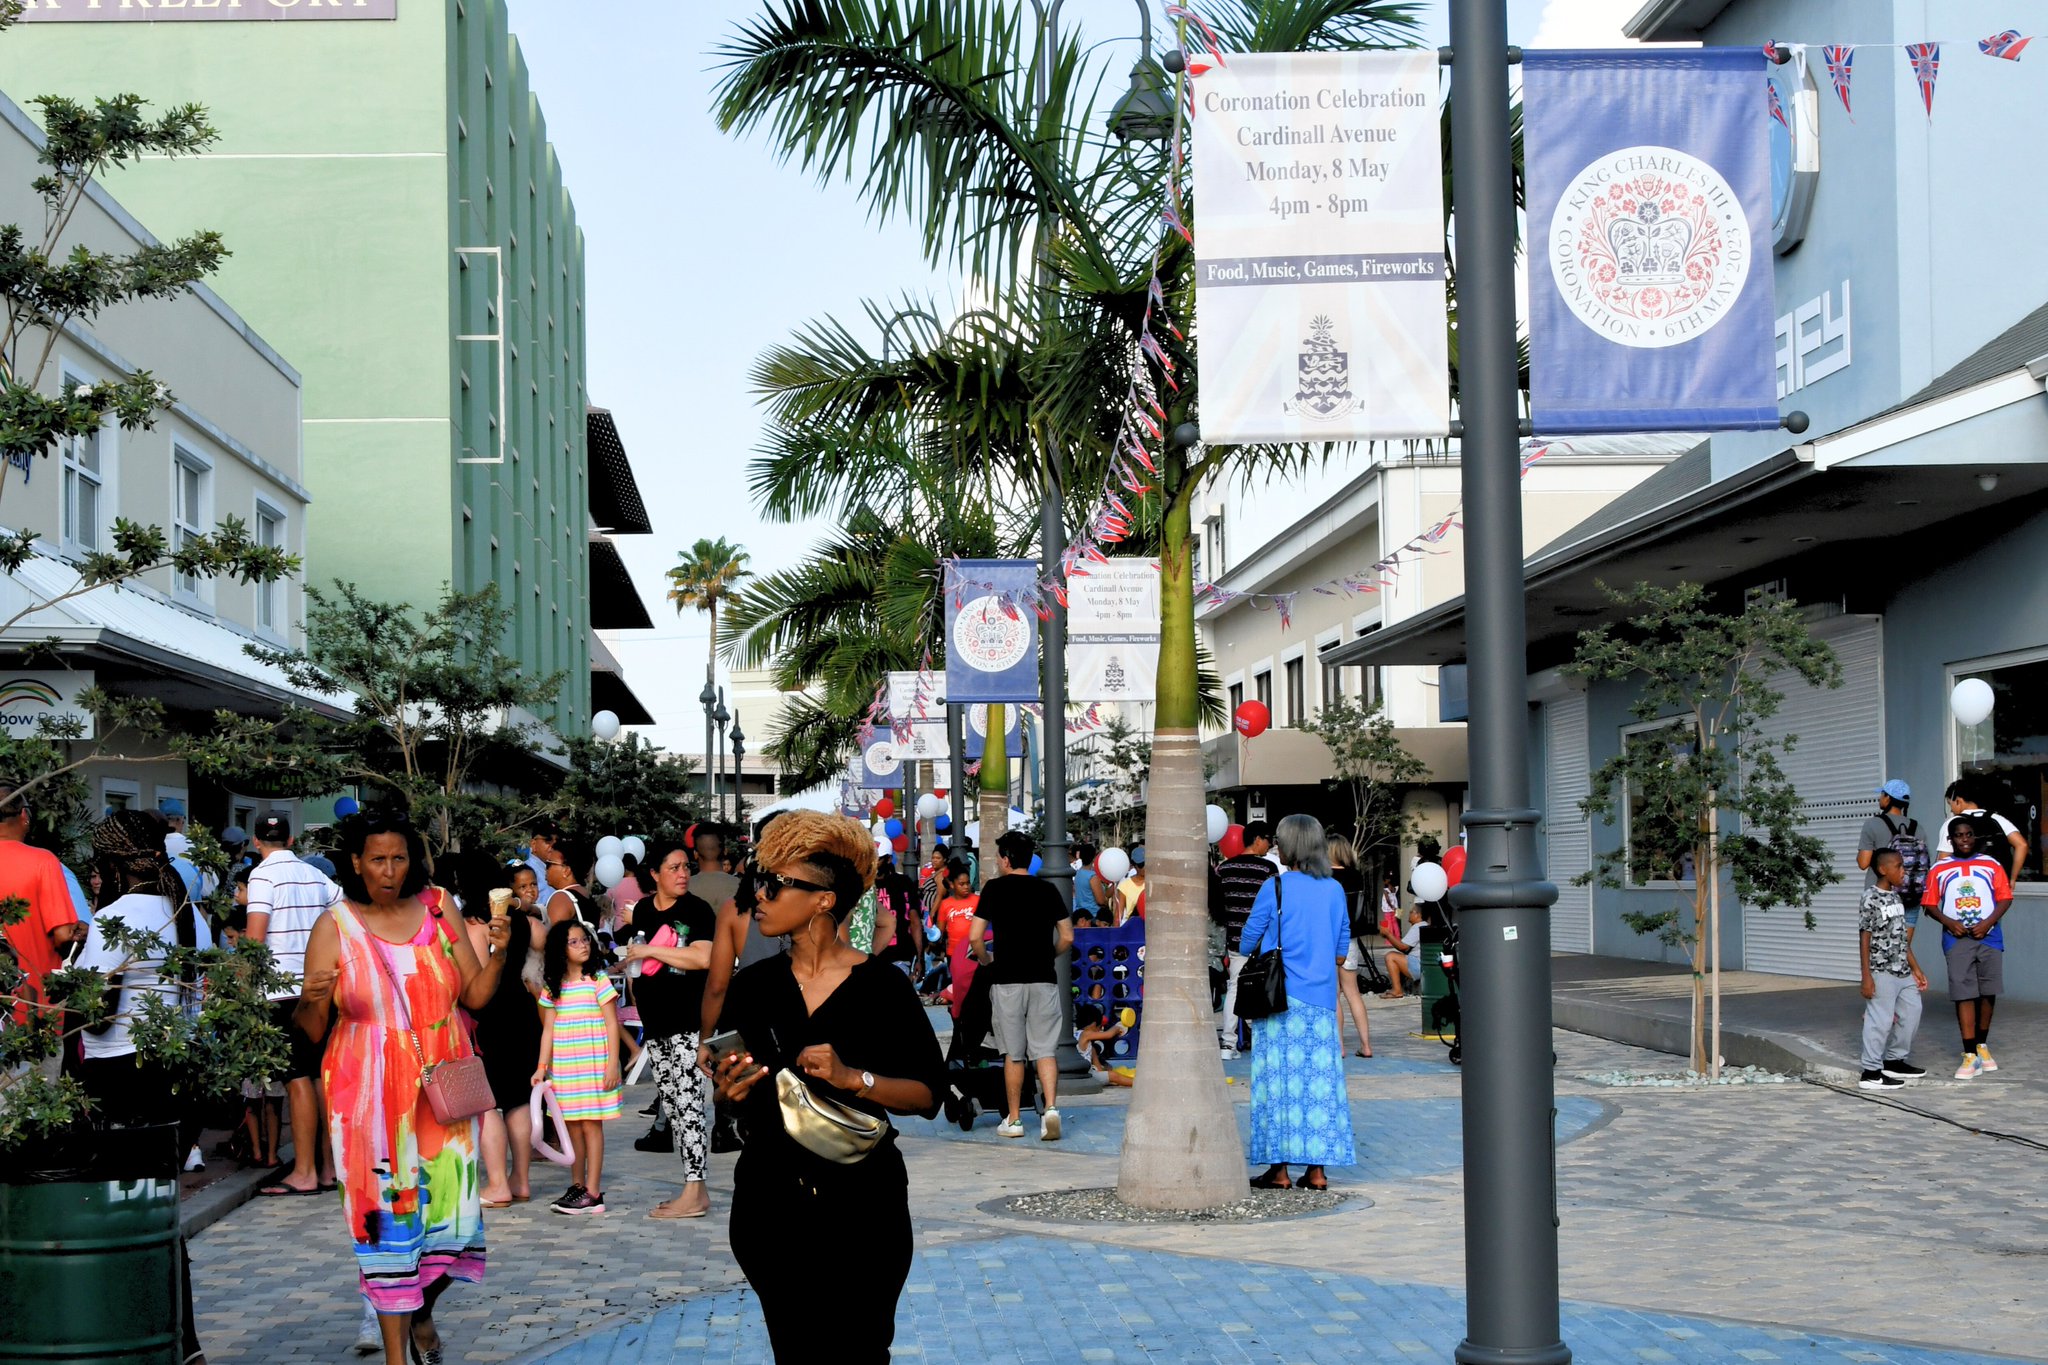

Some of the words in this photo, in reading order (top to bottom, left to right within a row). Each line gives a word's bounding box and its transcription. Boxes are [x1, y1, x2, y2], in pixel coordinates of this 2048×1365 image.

[1204, 90, 1311, 113] Coronation
[1316, 88, 1426, 110] Celebration
[1237, 124, 1325, 147] Cardinall
[1330, 123, 1397, 143] Avenue
[1245, 160, 1329, 184] Monday,
[1332, 158, 1343, 179] 8
[1348, 157, 1390, 182] May
[1569, 167, 1612, 211] KING
[1614, 155, 1710, 189] CHARLES
[1707, 184, 1730, 210] III
[1269, 195, 1310, 220] 4pm
[1328, 193, 1369, 219] 8pm
[1206, 263, 1249, 283] Food,
[1252, 261, 1301, 281] Music,
[1303, 260, 1359, 279] Games,
[1361, 258, 1435, 276] Fireworks
[1557, 228, 1641, 339] CORONATION
[1664, 312, 1706, 338] 6TH
[1702, 274, 1735, 320] MAY
[1725, 226, 1743, 274] 2023
[1083, 584, 1117, 593] Cardinall
[1119, 584, 1144, 593] Avenue
[1113, 571, 1155, 580] Celebration
